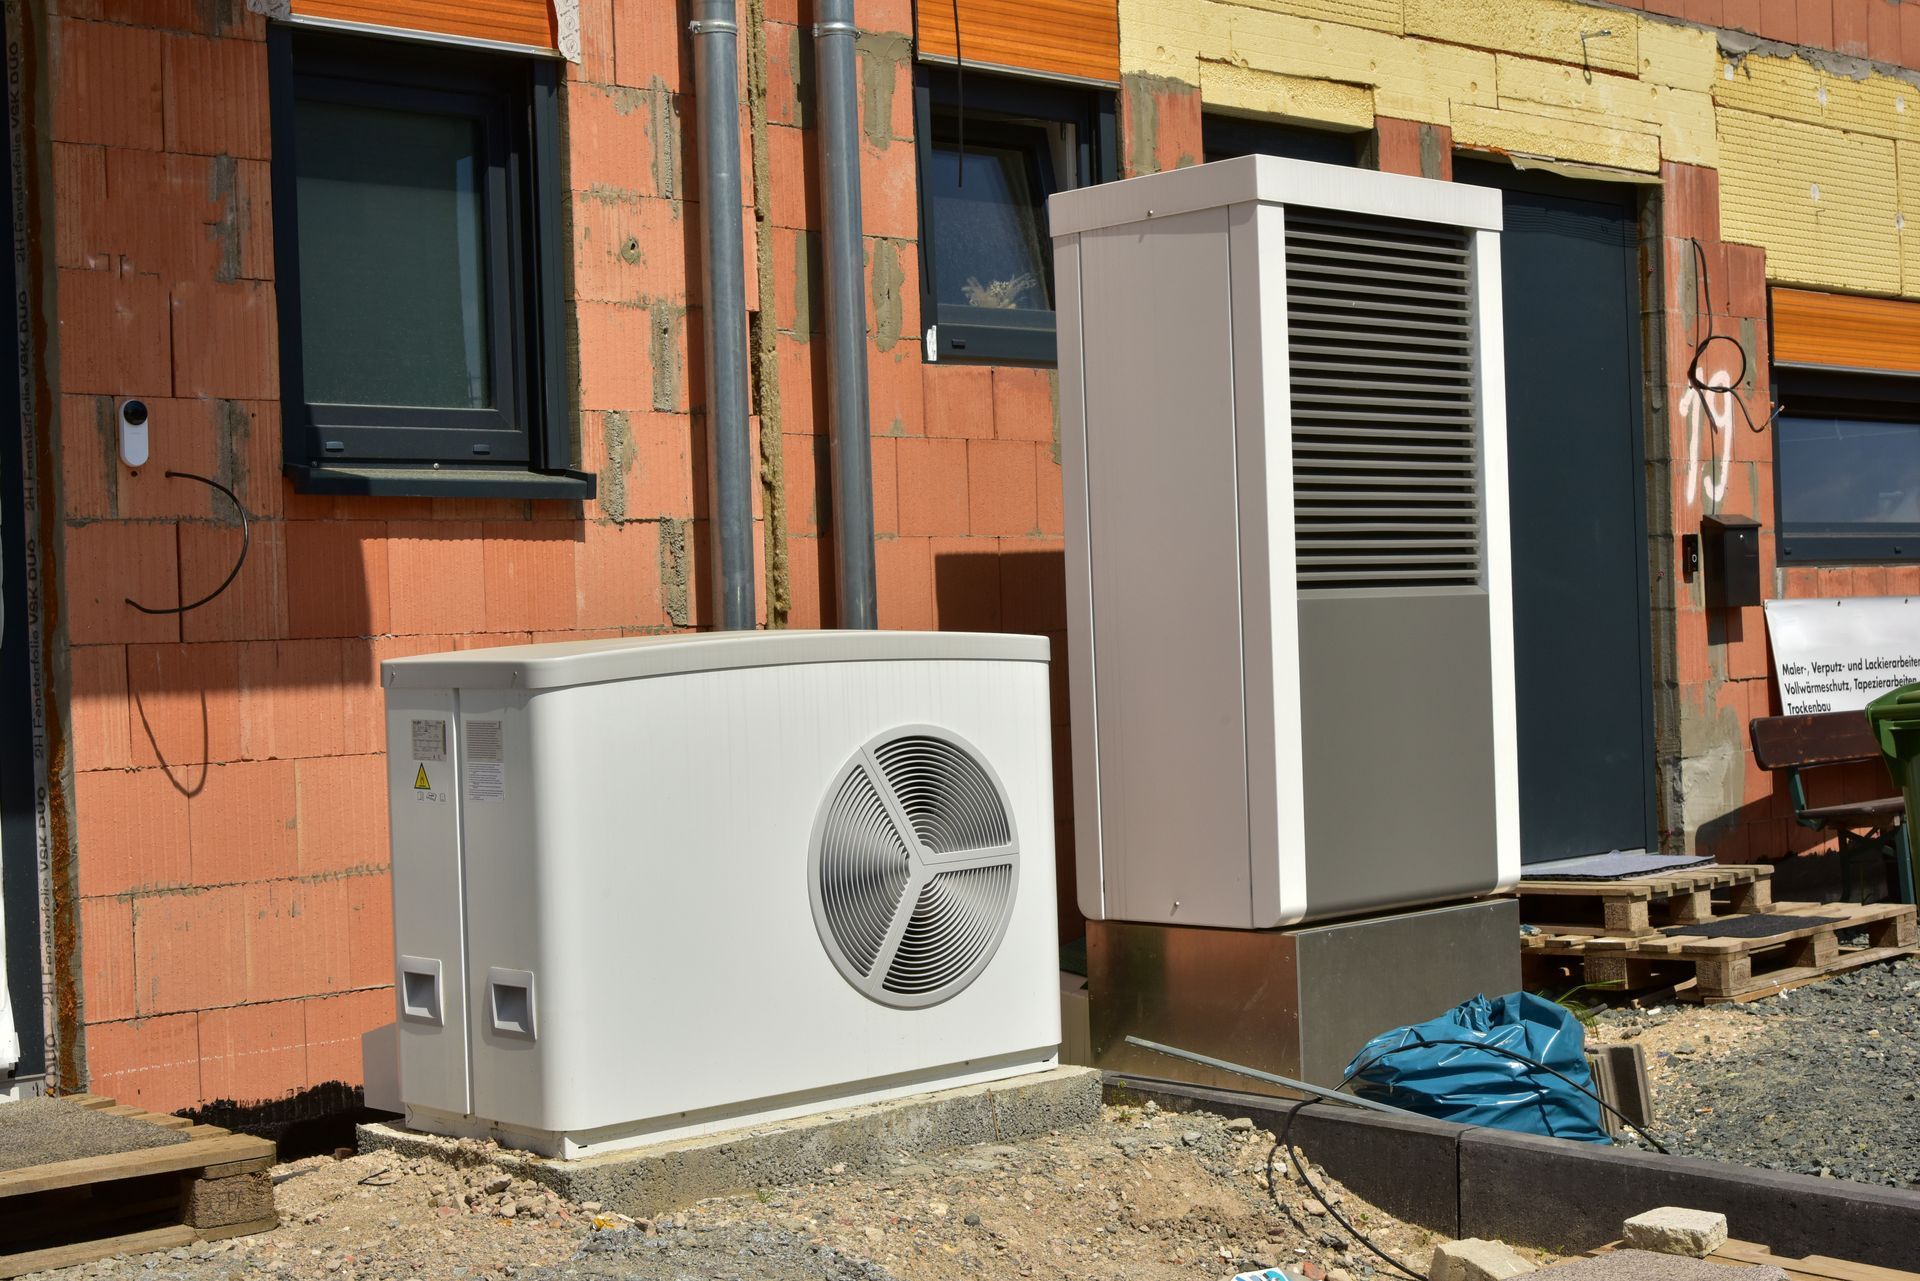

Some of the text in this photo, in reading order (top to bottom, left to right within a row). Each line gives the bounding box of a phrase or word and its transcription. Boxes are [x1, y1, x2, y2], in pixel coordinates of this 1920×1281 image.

[9, 42, 19, 84] DUO
[18, 291, 28, 333] DUO
[22, 382, 34, 480] Fensterfolie
[1679, 366, 1732, 504] 19
[27, 539, 43, 758] 2H Fensterfolie VSK DUO
[1782, 661, 1810, 676] Maler-,
[1811, 661, 1846, 677] Verputz-
[1847, 657, 1863, 671] und
[1784, 674, 1917, 695] Vollwärmeschutz, Tapezierarbeiten
[1787, 699, 1832, 714] Trockenbau
[37, 786, 54, 1007] 2H Fensterfolie VSK DUO
[45, 1034, 56, 1075] DUO
